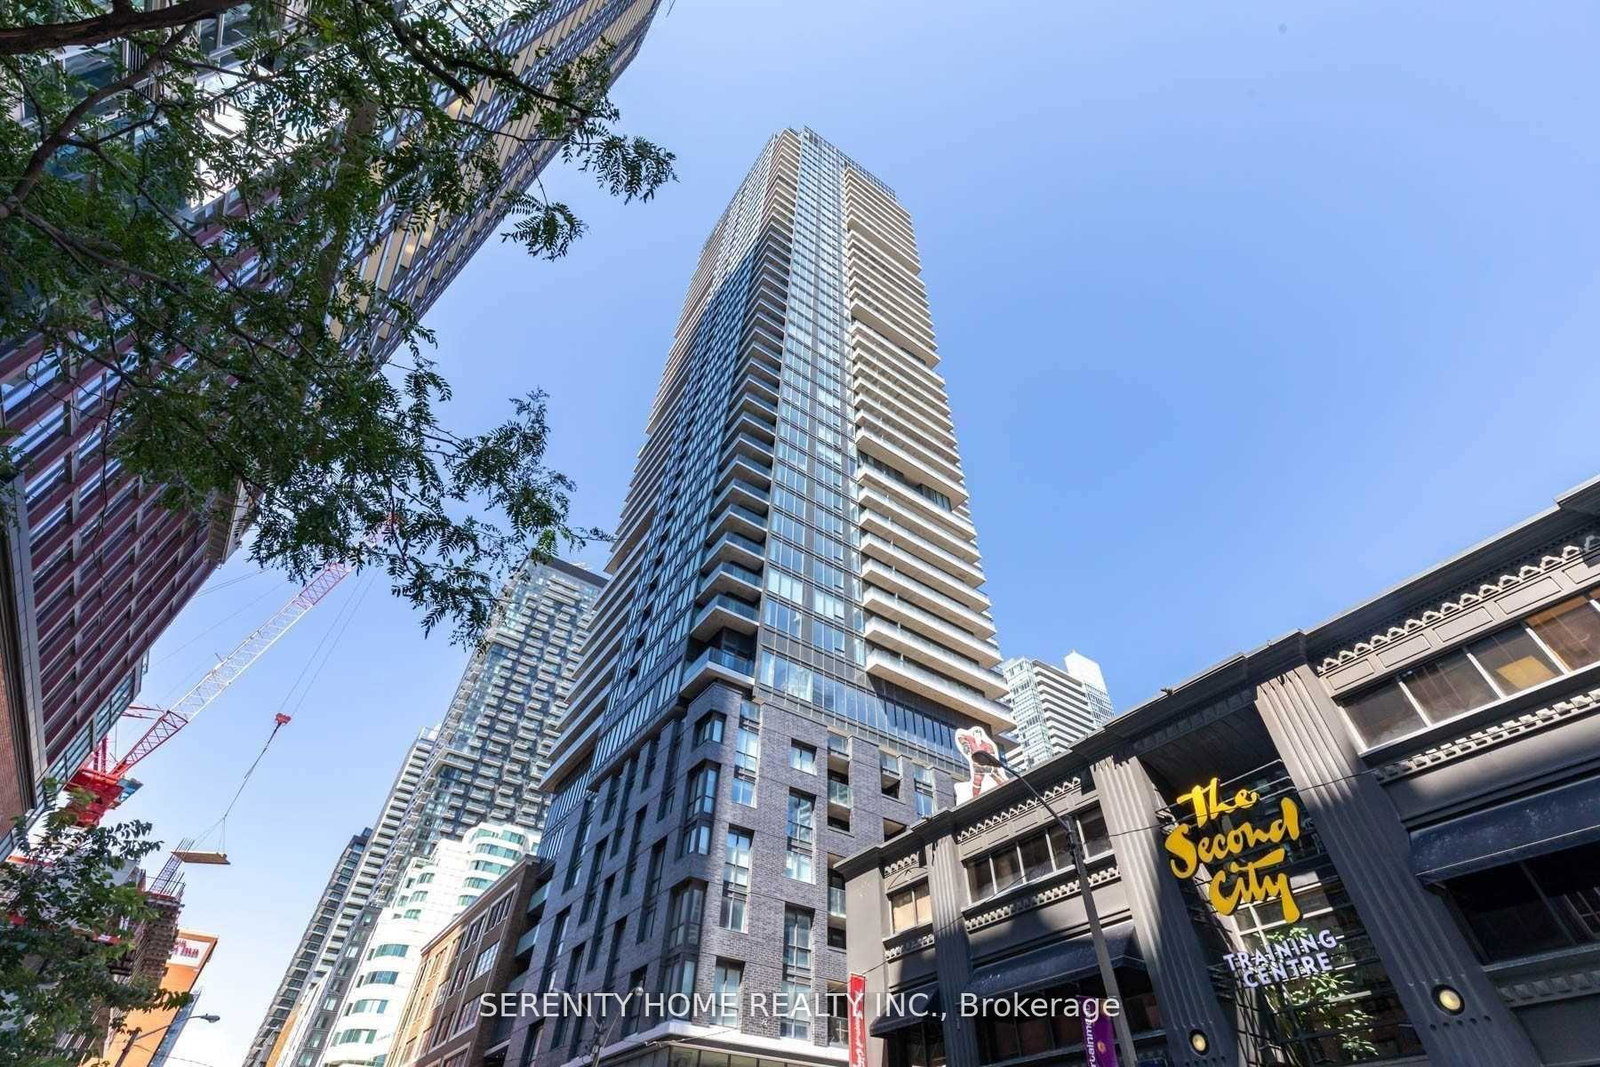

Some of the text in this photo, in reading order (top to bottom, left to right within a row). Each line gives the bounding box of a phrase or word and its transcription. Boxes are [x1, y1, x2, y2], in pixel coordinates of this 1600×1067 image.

[1177, 777, 1260, 828] The
[1164, 797, 1300, 879] Second
[1208, 848, 1300, 923] City
[1223, 930, 1337, 972] TRAINING
[1243, 952, 1333, 988] CENTRE
